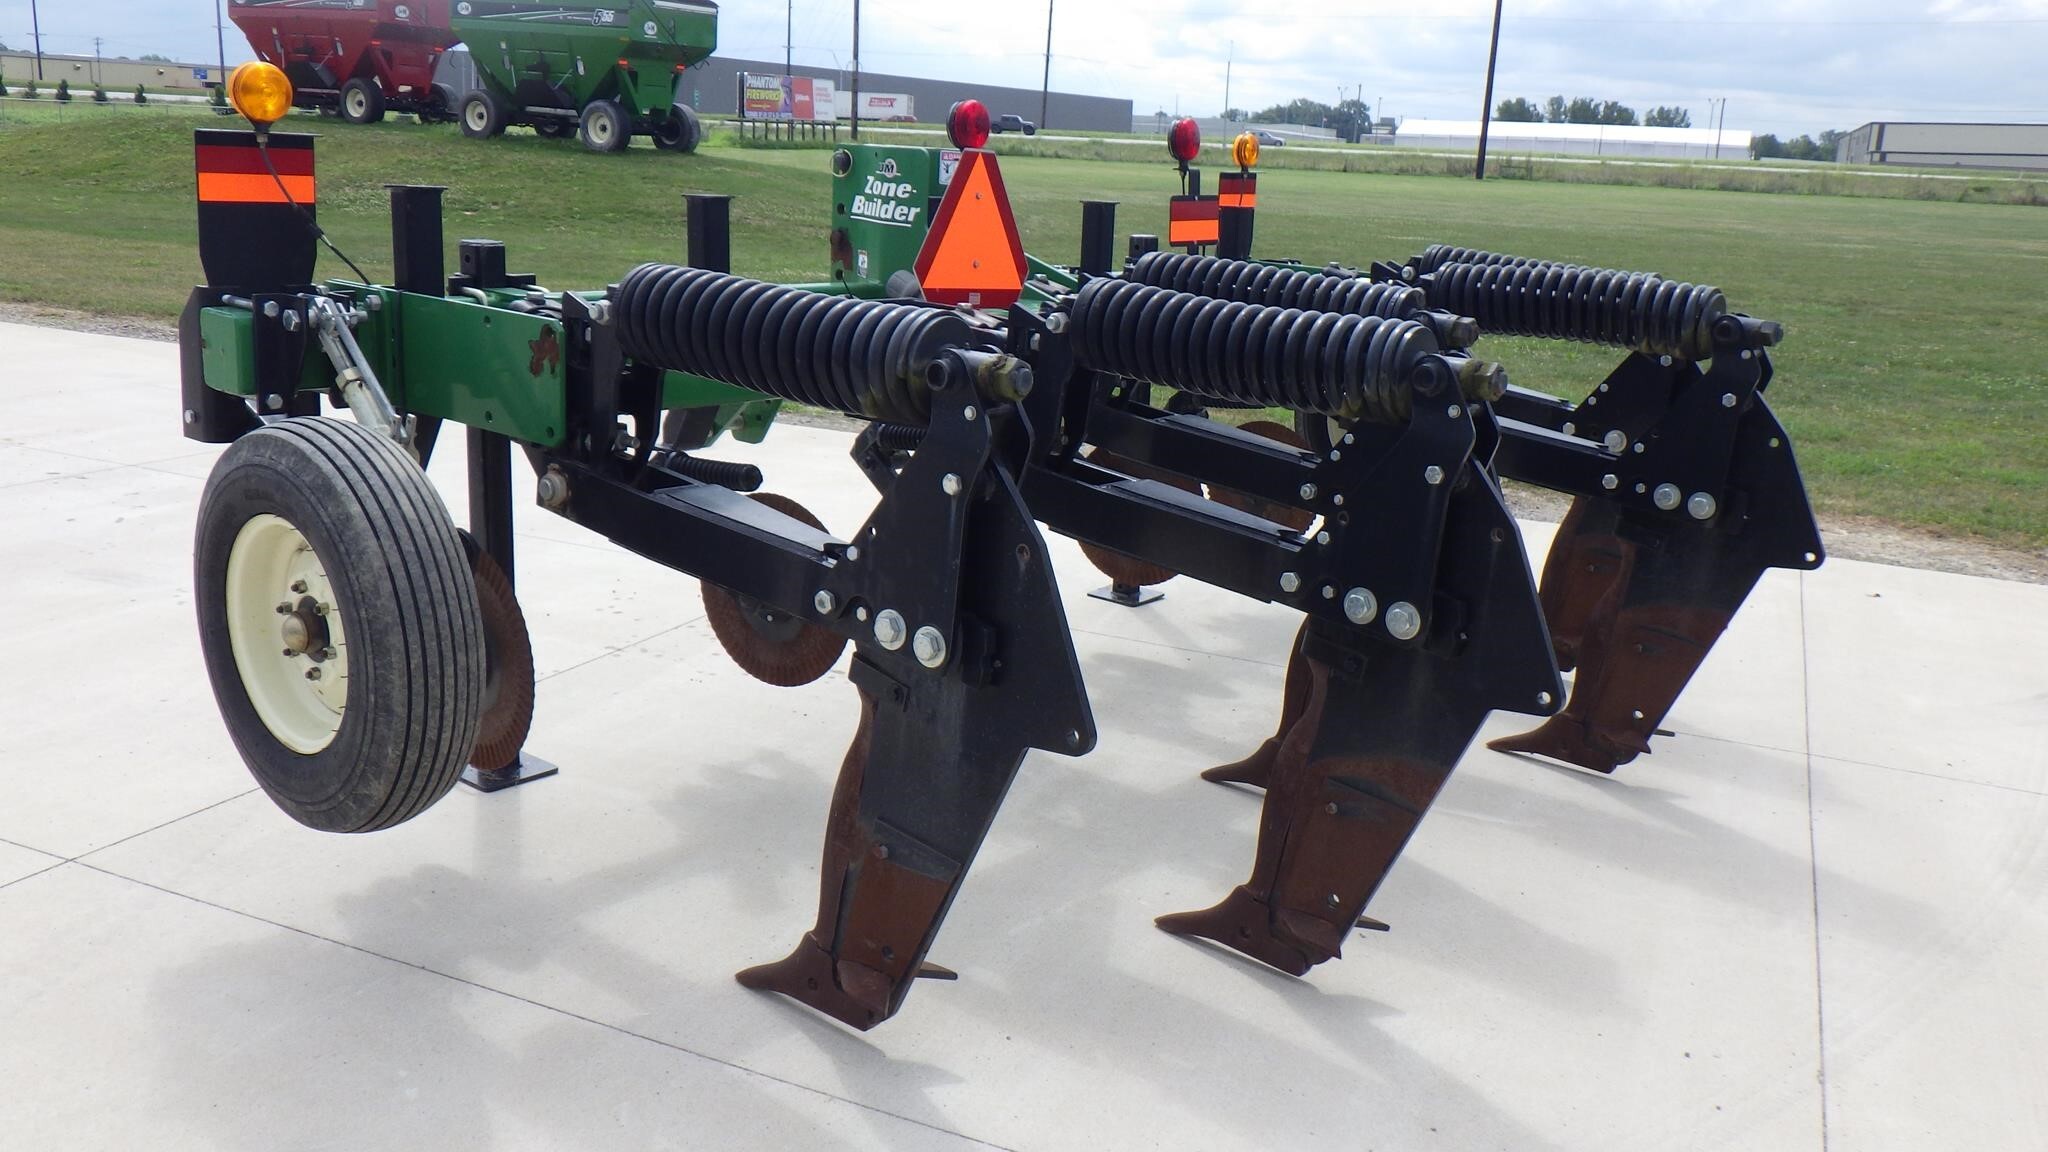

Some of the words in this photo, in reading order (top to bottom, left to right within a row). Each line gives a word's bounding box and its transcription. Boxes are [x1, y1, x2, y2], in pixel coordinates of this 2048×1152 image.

[746, 75, 780, 89] PHANTOM
[864, 175, 917, 198] Zone-
[851, 194, 921, 222] Builder
